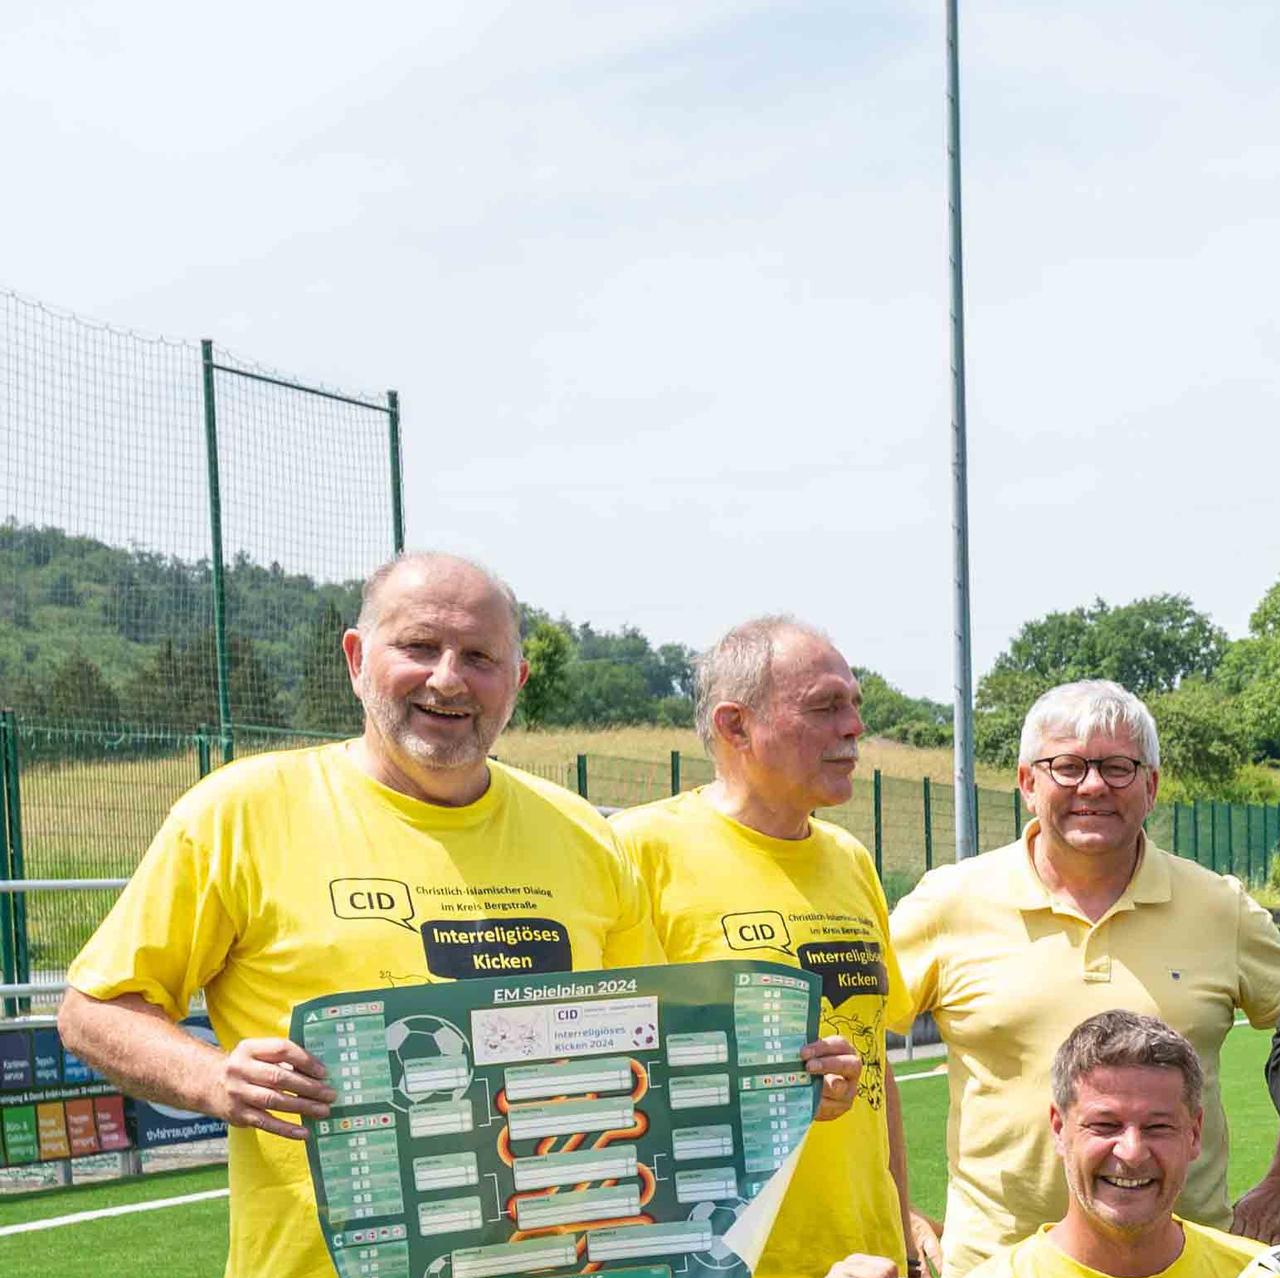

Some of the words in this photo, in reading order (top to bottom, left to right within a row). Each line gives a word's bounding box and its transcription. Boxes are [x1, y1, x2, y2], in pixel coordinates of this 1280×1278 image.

[415, 885, 522, 898] Christlich-Islamischer
[349, 891, 396, 911] CID
[441, 903, 455, 912] im
[456, 902, 482, 912] Kreis
[484, 901, 538, 912] Bergstraße
[432, 926, 561, 946] Interreligiöses
[738, 923, 775, 942] CID
[472, 954, 533, 970] Kicken
[837, 971, 878, 987] Kicken
[493, 987, 520, 1001] EM
[523, 983, 594, 1001] Spielplan
[598, 978, 638, 994] 2024
[557, 1009, 579, 1021] CID
[589, 1038, 615, 1049] 2024
